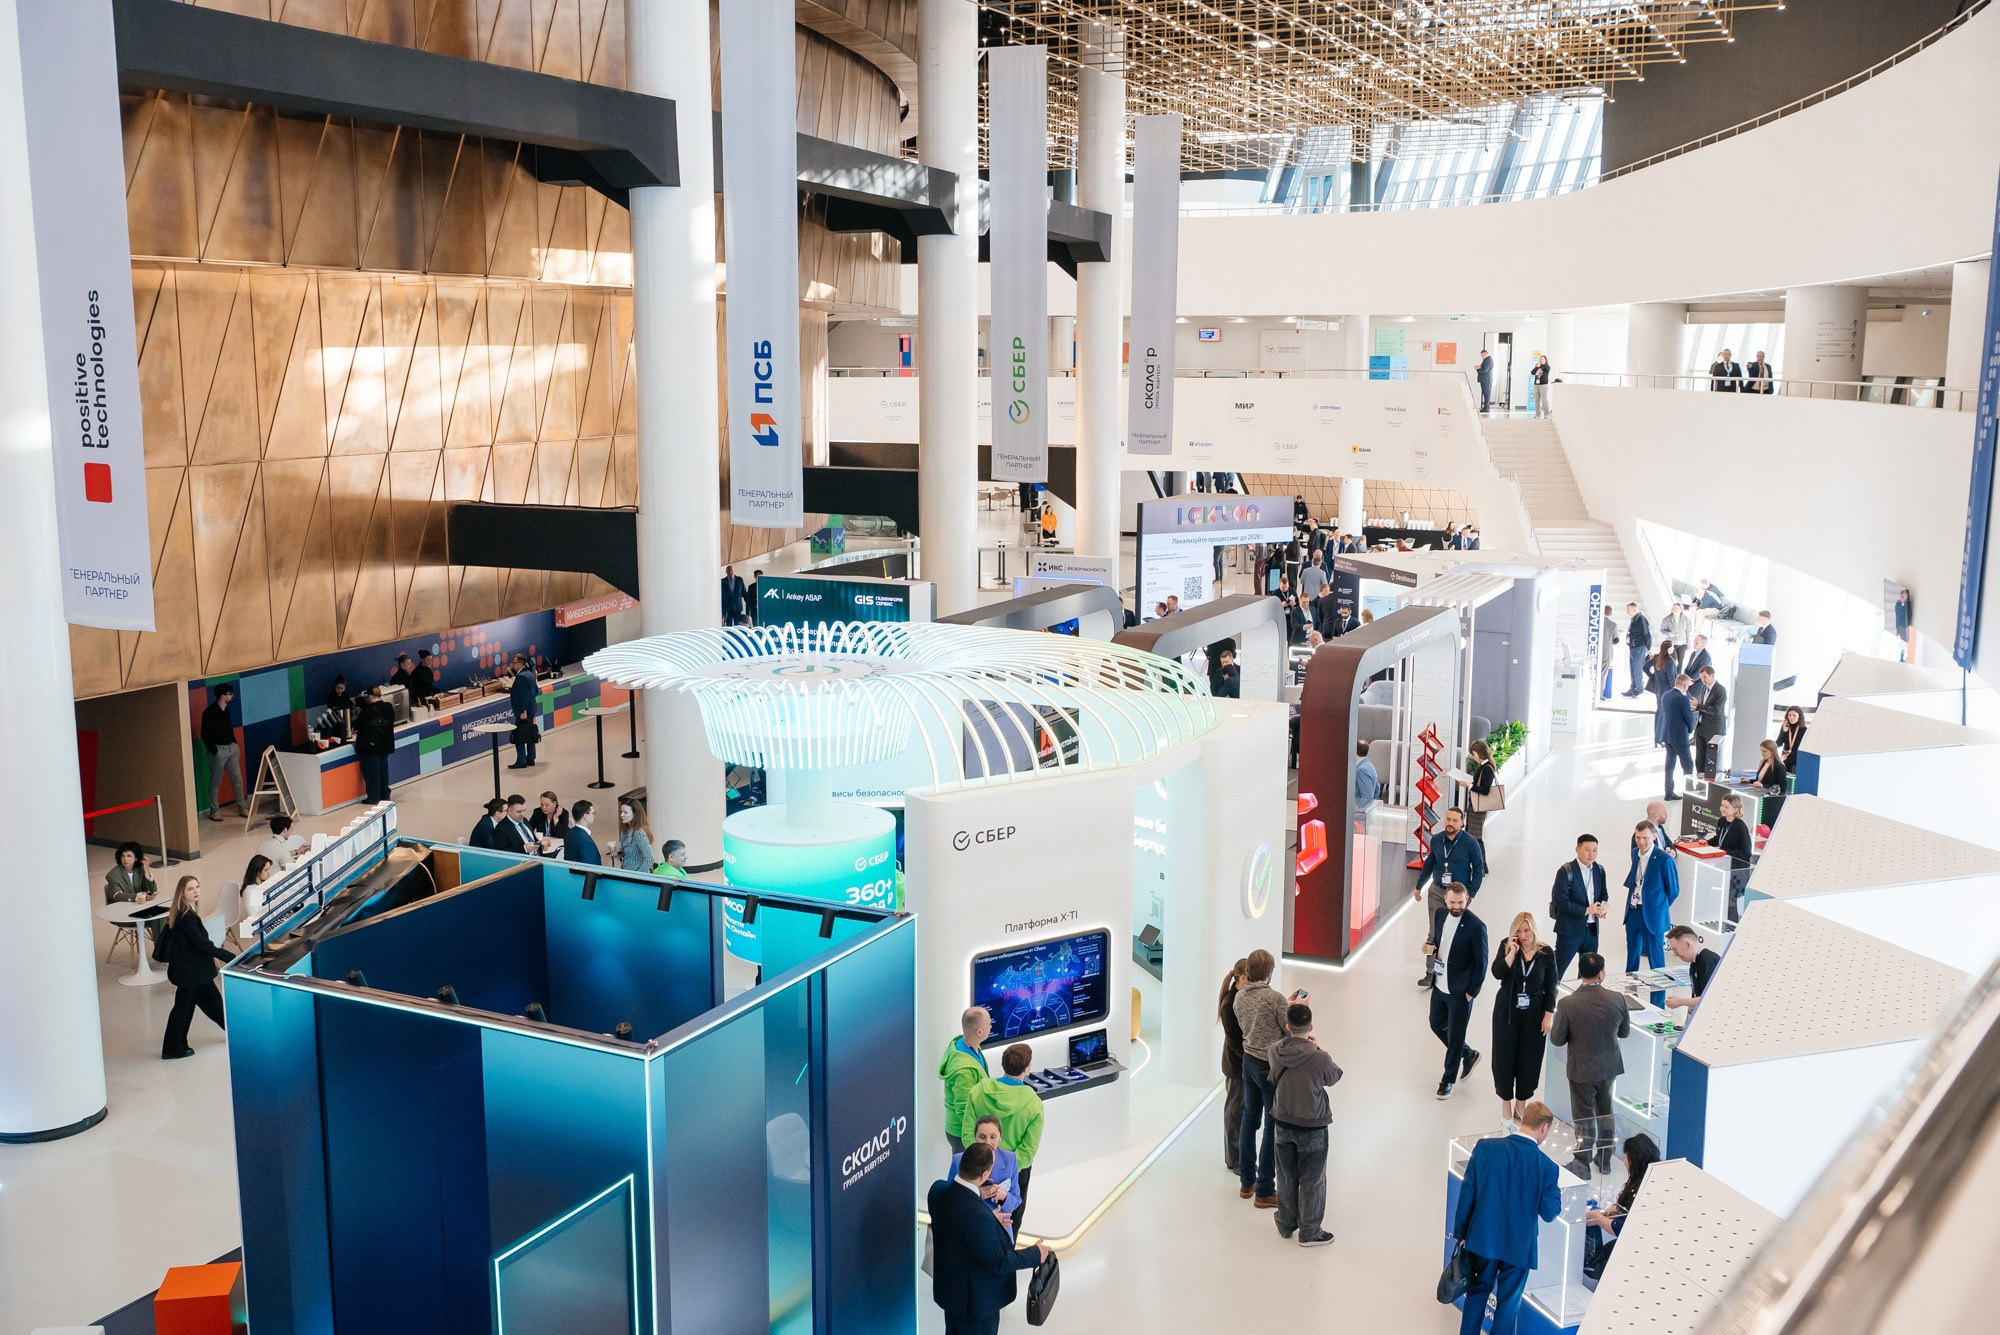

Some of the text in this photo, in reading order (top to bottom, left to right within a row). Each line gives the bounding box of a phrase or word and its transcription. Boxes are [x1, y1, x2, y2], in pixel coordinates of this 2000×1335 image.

[87, 289, 109, 449] technologies
[753, 340, 773, 403] ПСБ
[1012, 336, 1026, 393] СБЕР
[74, 352, 95, 448] positive
[1234, 402, 1255, 410] МИР
[996, 453, 1041, 463] ГЕНЕРАЛЬНЫЙ
[1005, 461, 1034, 470] ПАРТНЕР
[738, 488, 794, 499] ГЕНЕРАЛЬНЫЙ
[748, 500, 785, 509] ПАРТНЕР
[1048, 564, 1063, 572] ИКС
[85, 585, 129, 600] ПАРТНЕР
[785, 592, 823, 603] Ankey ASAP
[854, 594, 874, 606] GIS
[566, 599, 618, 621] КИБЕРБЕЗОПАСНО
[975, 825, 1016, 844] СБЕР
[868, 851, 889, 866] СБЕР
[1004, 916, 1058, 933] Платформа
[975, 955, 999, 965] Платформа
[843, 1148, 890, 1190] ГРУППА RUBYTECH
